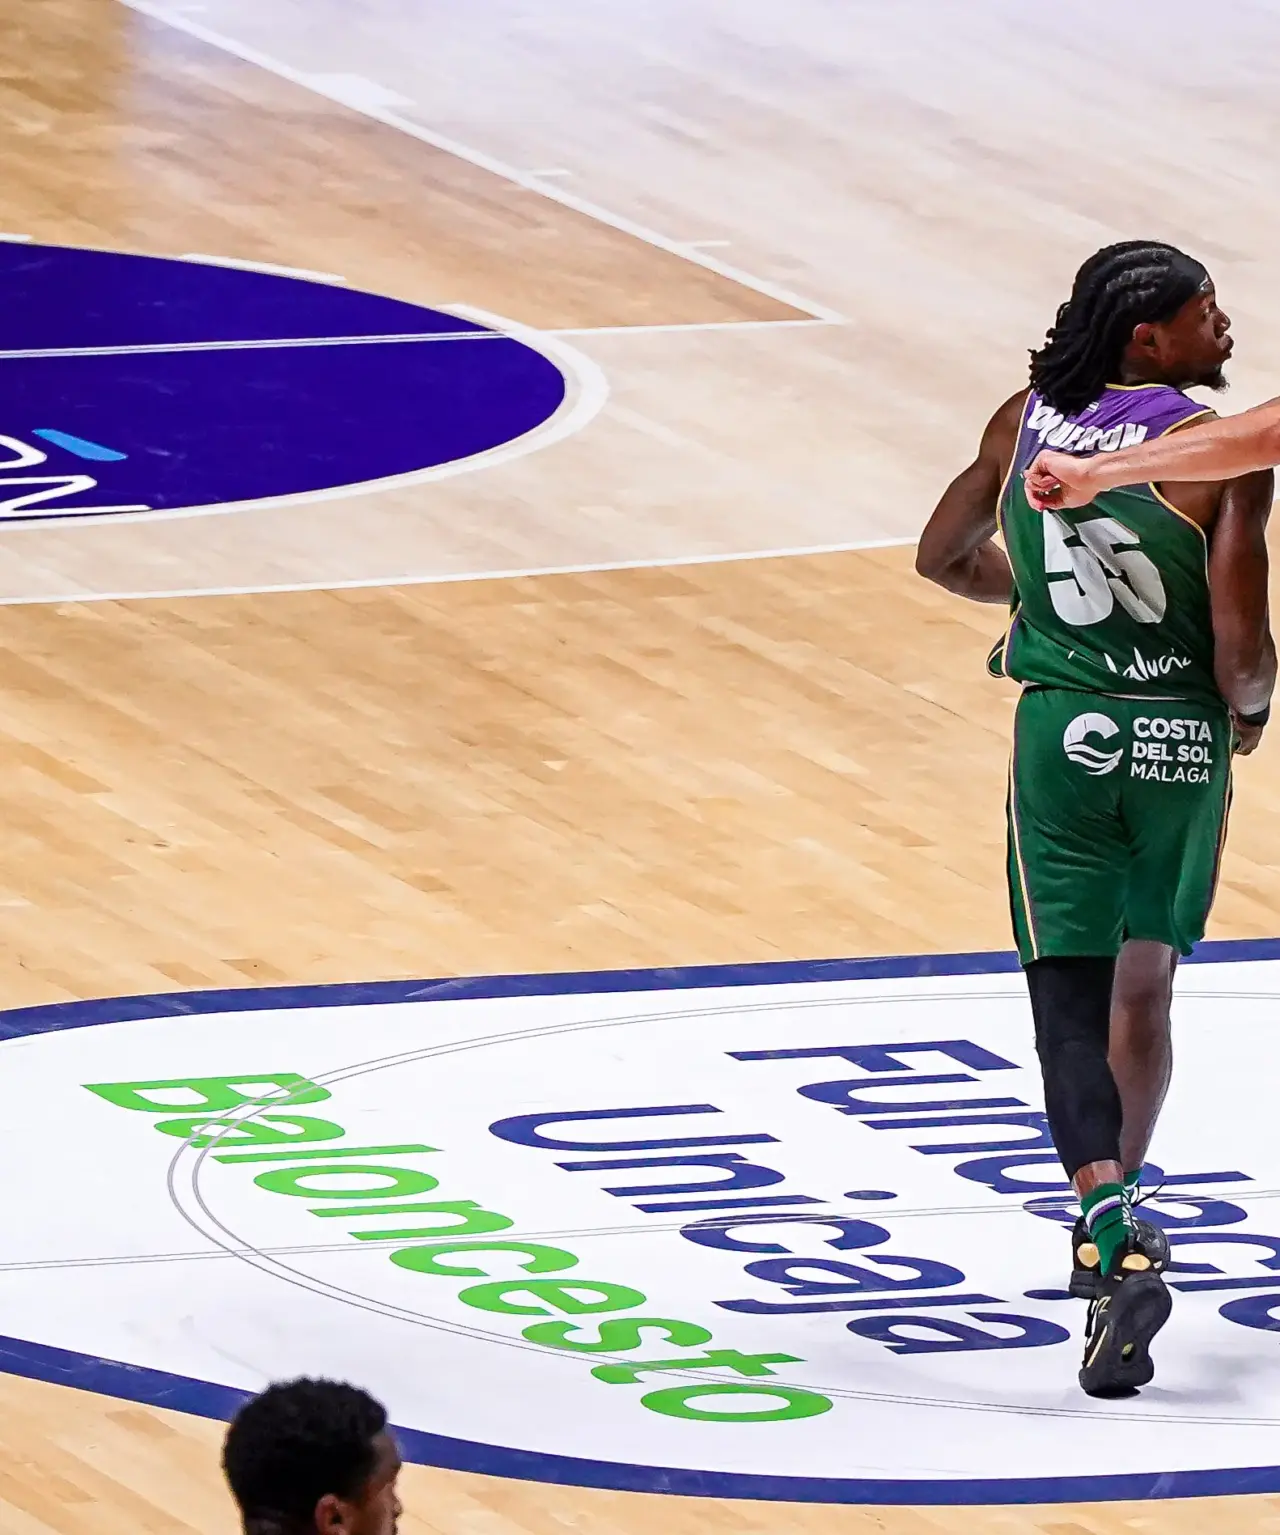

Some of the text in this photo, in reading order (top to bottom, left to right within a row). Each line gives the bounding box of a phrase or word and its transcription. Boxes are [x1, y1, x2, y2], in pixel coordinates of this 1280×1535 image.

[1043, 509, 1167, 626] 55
[1131, 741, 1213, 764] DEL SOL
[1132, 717, 1213, 742] COSTA
[1130, 761, 1210, 784] MÁLAGA
[81, 1072, 834, 1423] Baloncesto
[488, 1103, 1076, 1355] Unicaja
